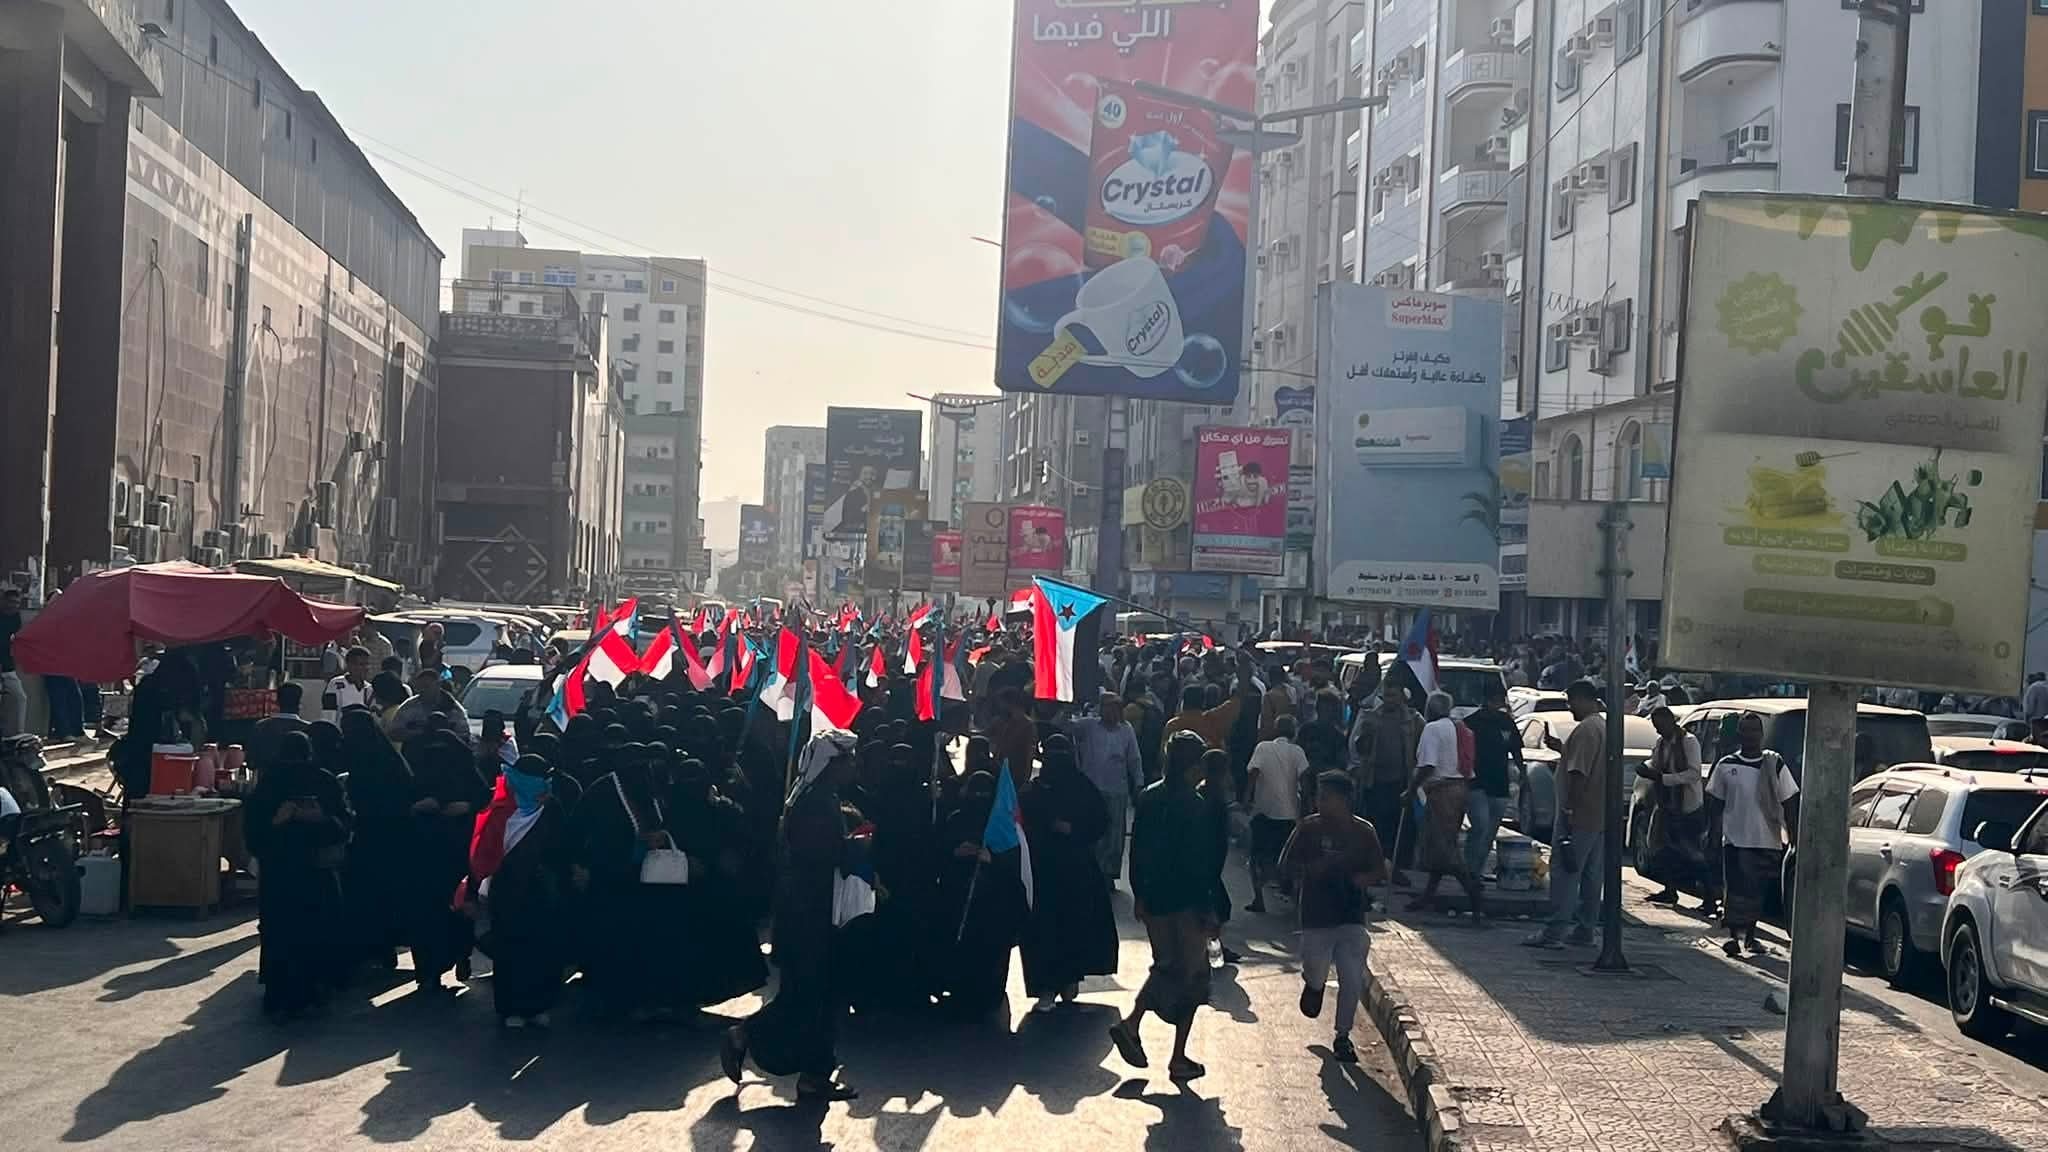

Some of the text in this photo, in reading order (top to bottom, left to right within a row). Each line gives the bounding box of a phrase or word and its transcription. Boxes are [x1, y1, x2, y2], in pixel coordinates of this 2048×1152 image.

[1033, 9, 1170, 53] اللي فيها
[1103, 101, 1121, 118] 40
[1102, 168, 1206, 206] Crystal
[1391, 312, 1444, 326] SuperMax
[1128, 304, 1165, 352] Crystal
[1420, 368, 1447, 384] عالية
[1200, 430, 1230, 443] مكان
[1244, 432, 1261, 446] من
